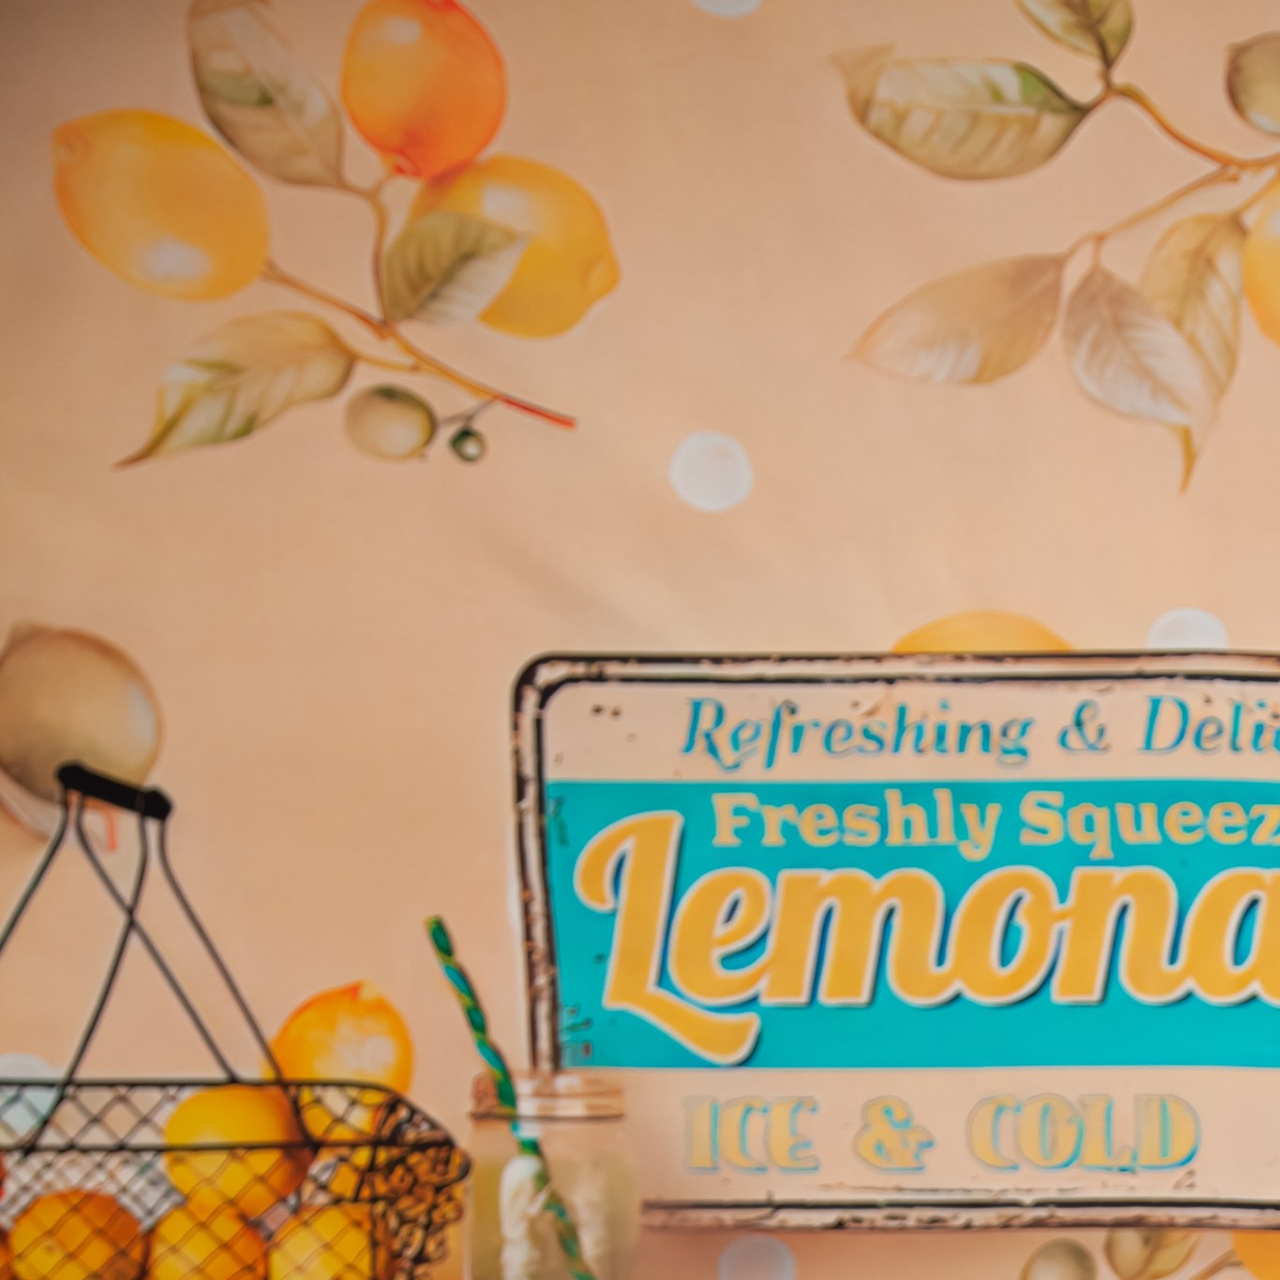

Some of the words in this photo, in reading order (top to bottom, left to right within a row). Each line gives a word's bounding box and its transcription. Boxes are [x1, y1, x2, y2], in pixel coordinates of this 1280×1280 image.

[682, 697, 1034, 770] Refreshing
[1057, 699, 1110, 752] &
[711, 788, 1001, 862] Freshly
[684, 1095, 820, 1172] ICE
[853, 1096, 935, 1171] &
[966, 1093, 1201, 1172] COLD
